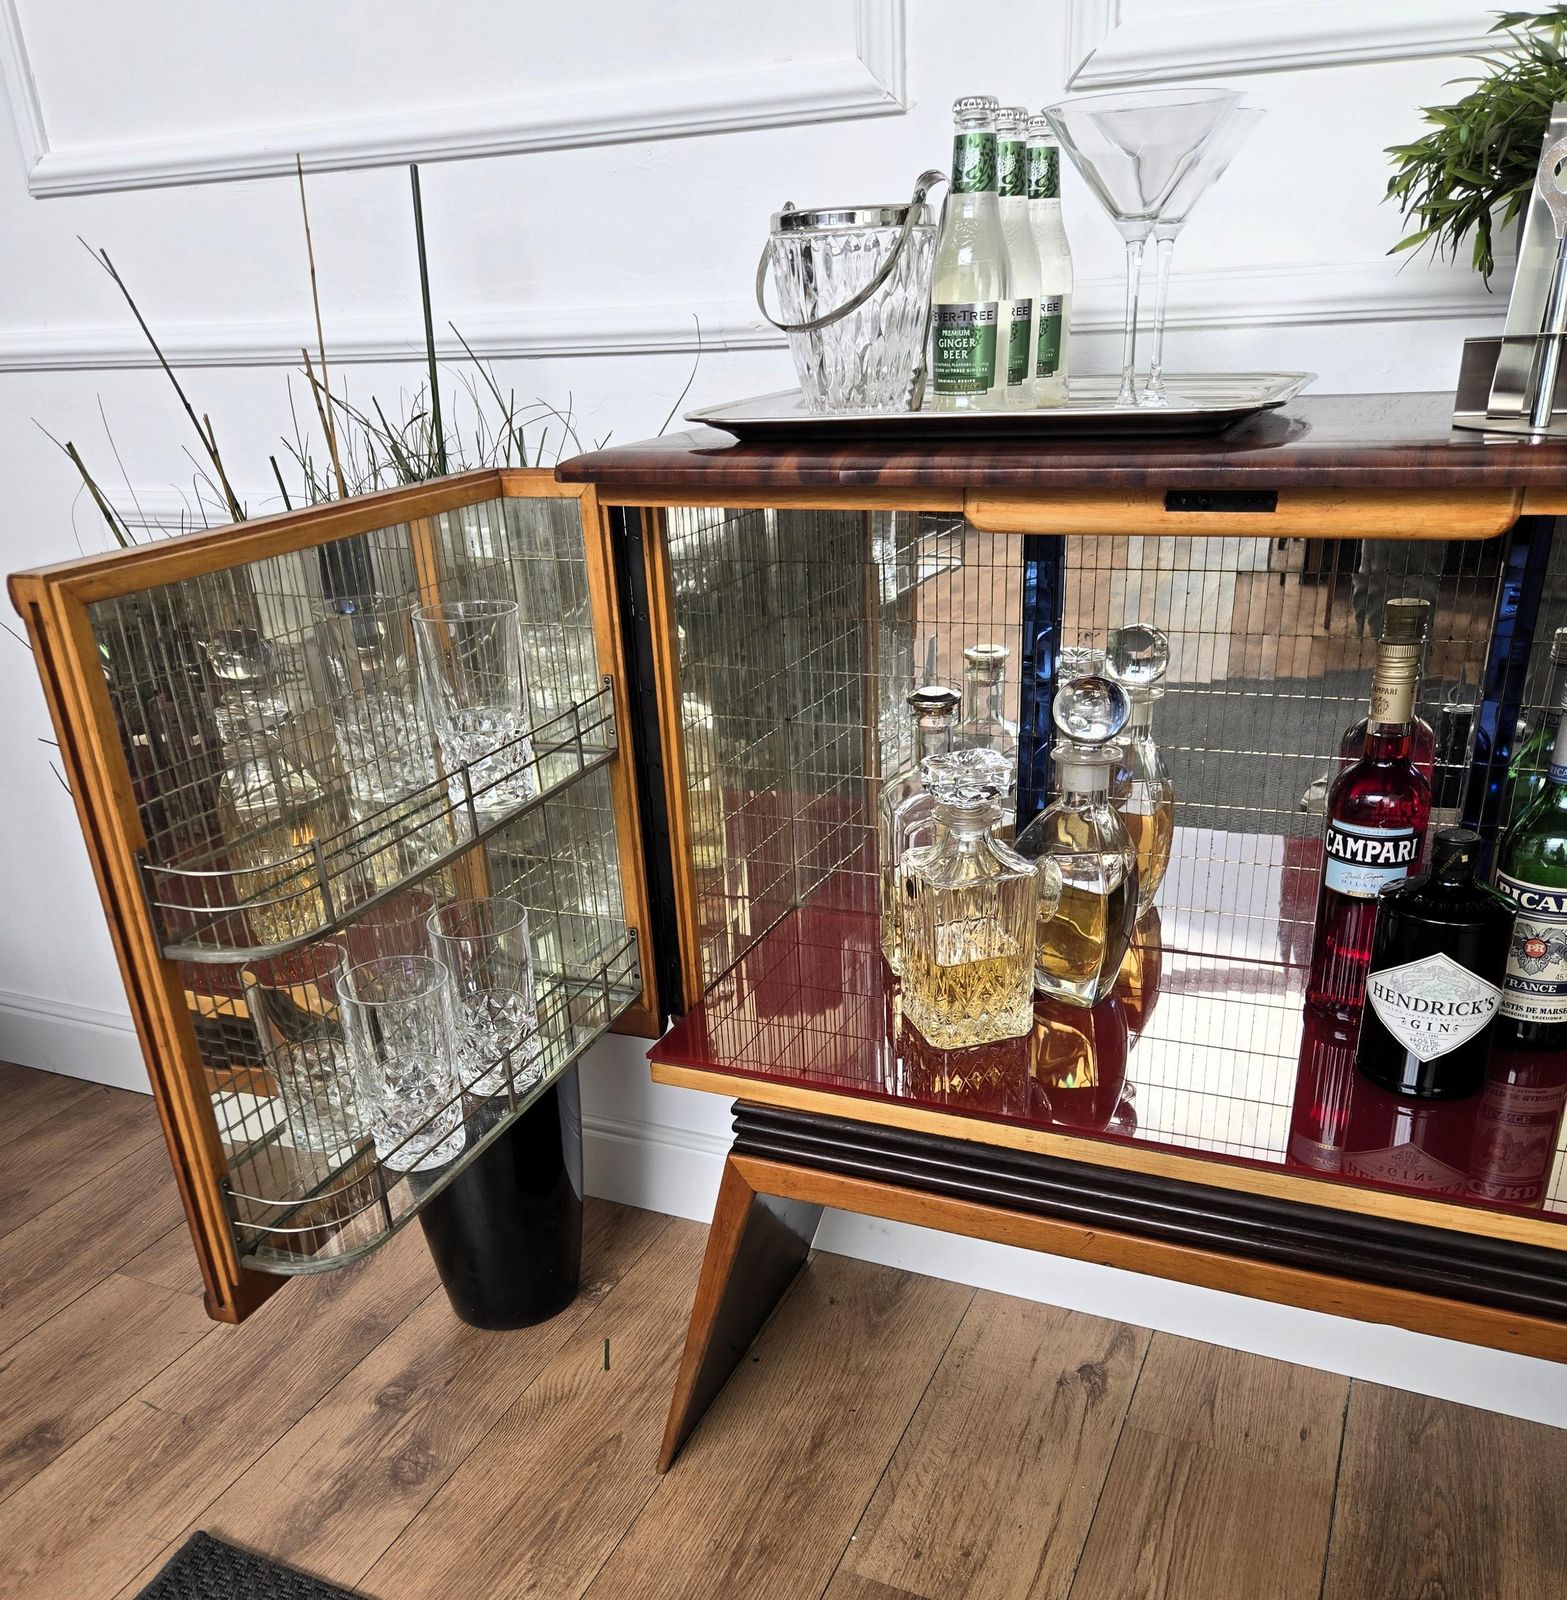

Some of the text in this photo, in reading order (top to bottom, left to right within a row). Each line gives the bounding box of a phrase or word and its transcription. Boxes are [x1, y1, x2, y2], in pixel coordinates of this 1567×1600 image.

[941, 329, 971, 337] PREMIUM
[938, 338, 977, 348] GINGER
[943, 350, 969, 359] BEER
[1325, 828, 1418, 863] CAMPARI
[1526, 942, 1547, 954] PR
[1373, 980, 1496, 1016] HENDRICK'S
[1501, 1000, 1567, 1016] ASTIS DE MARSE
[1410, 1019, 1451, 1033] GIN
